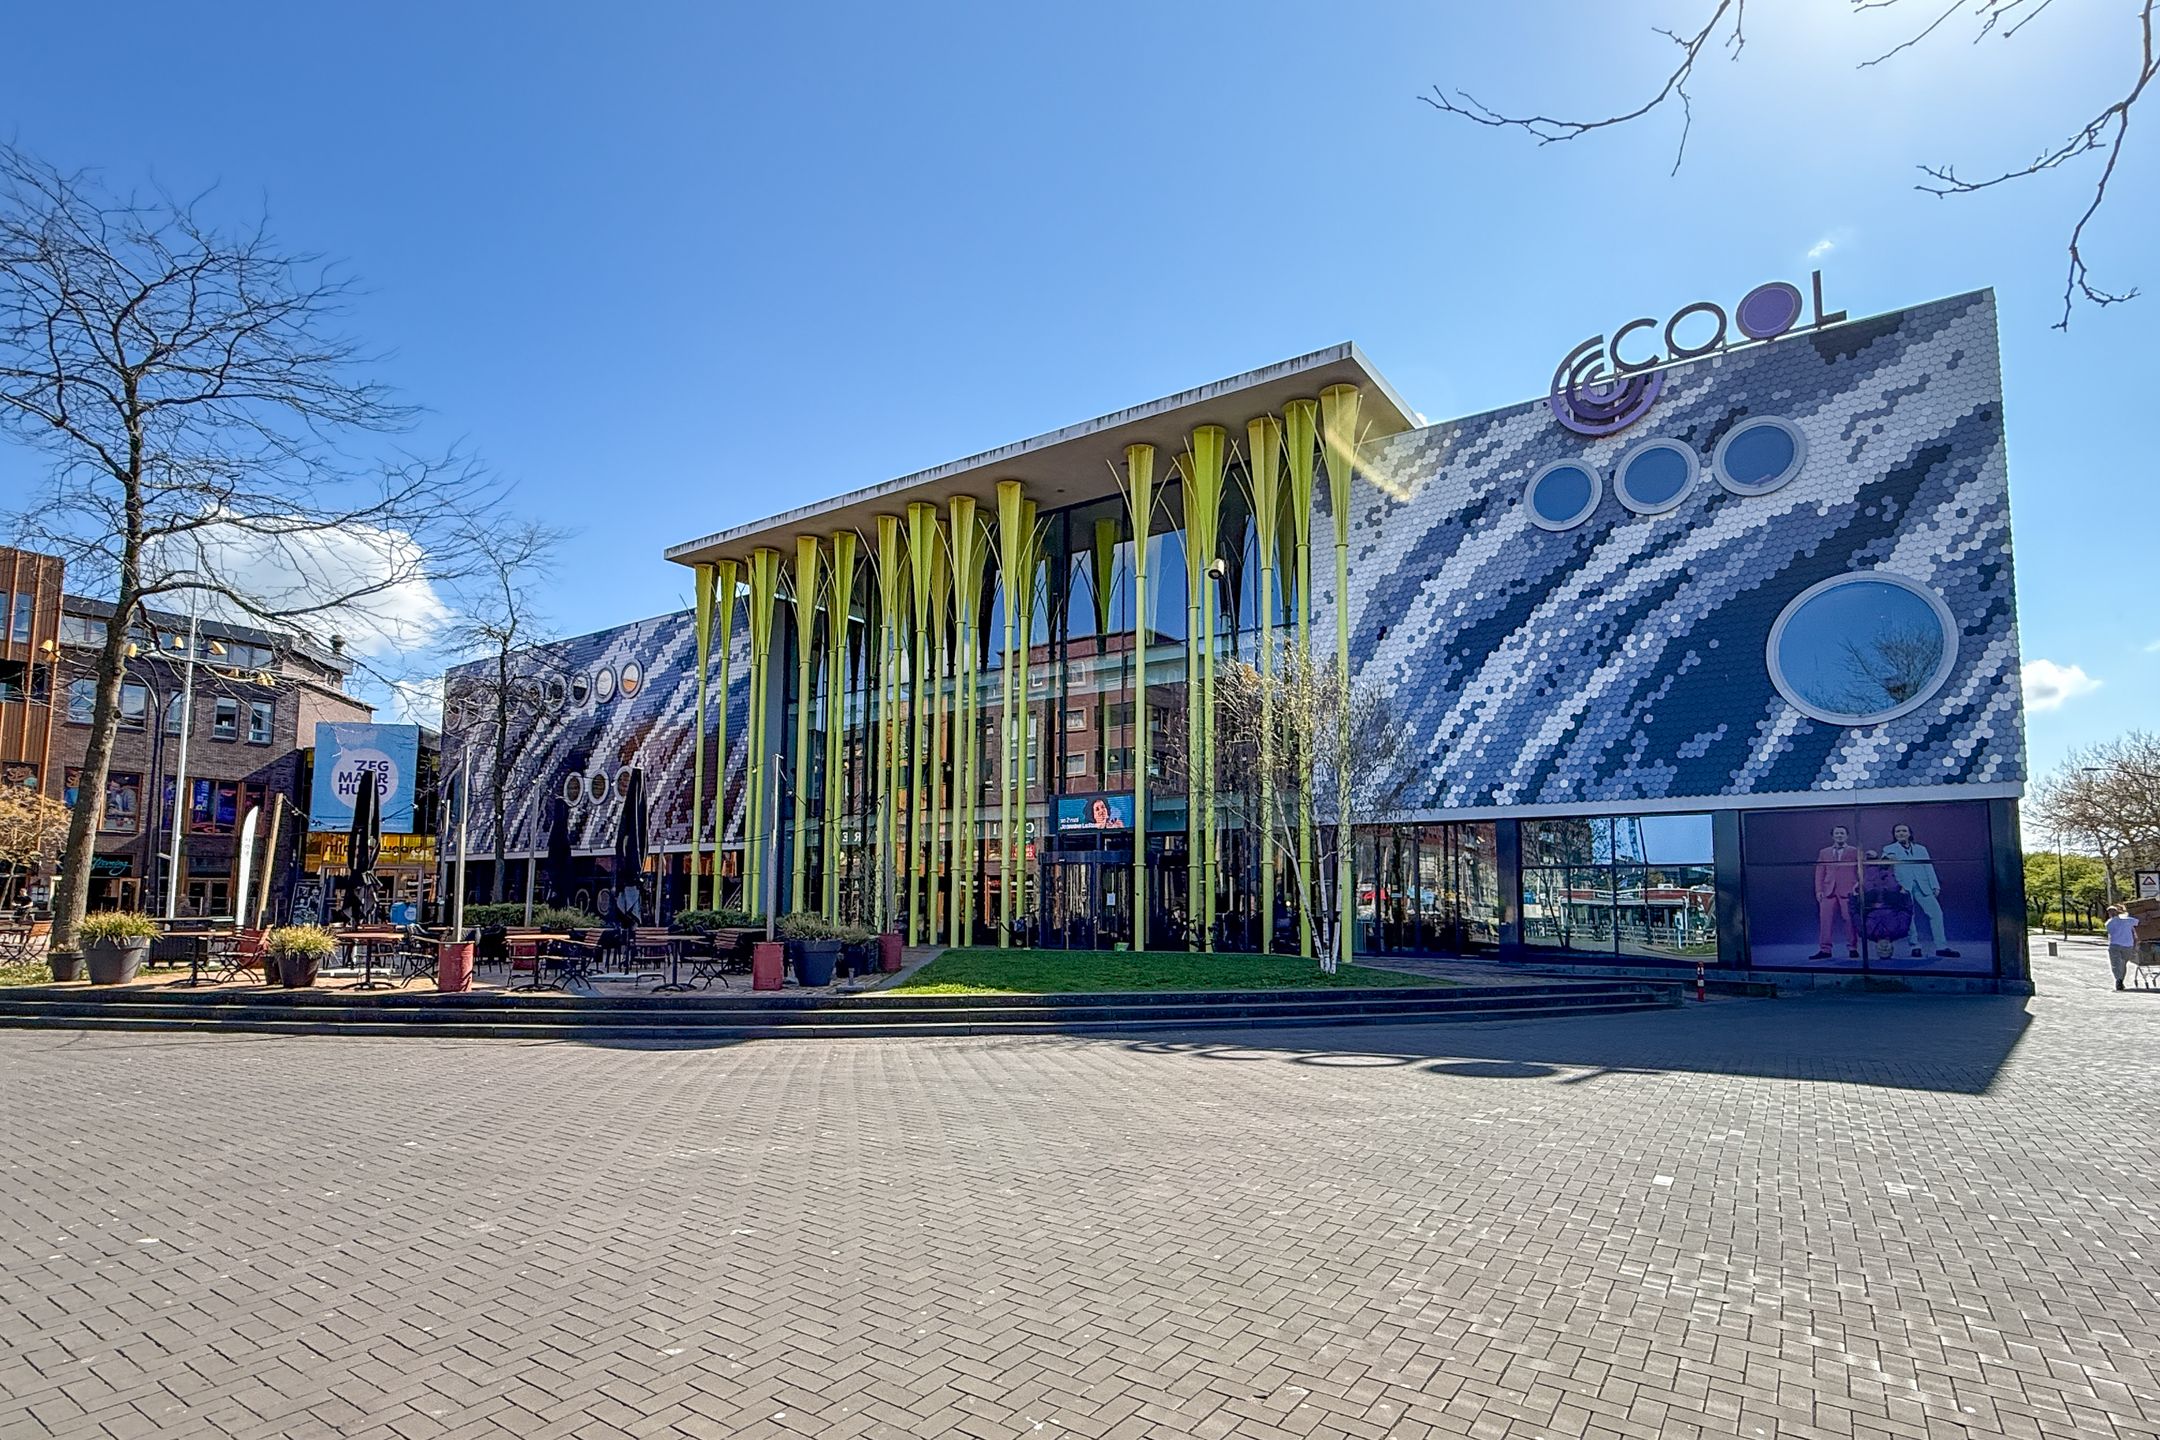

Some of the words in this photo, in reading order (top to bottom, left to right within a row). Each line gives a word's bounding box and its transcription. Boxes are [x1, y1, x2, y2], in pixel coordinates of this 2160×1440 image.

[1610, 270, 1847, 373] COOL
[354, 760, 389, 772] ZEG
[338, 771, 389, 784] MAR
[338, 783, 388, 796] HUO
